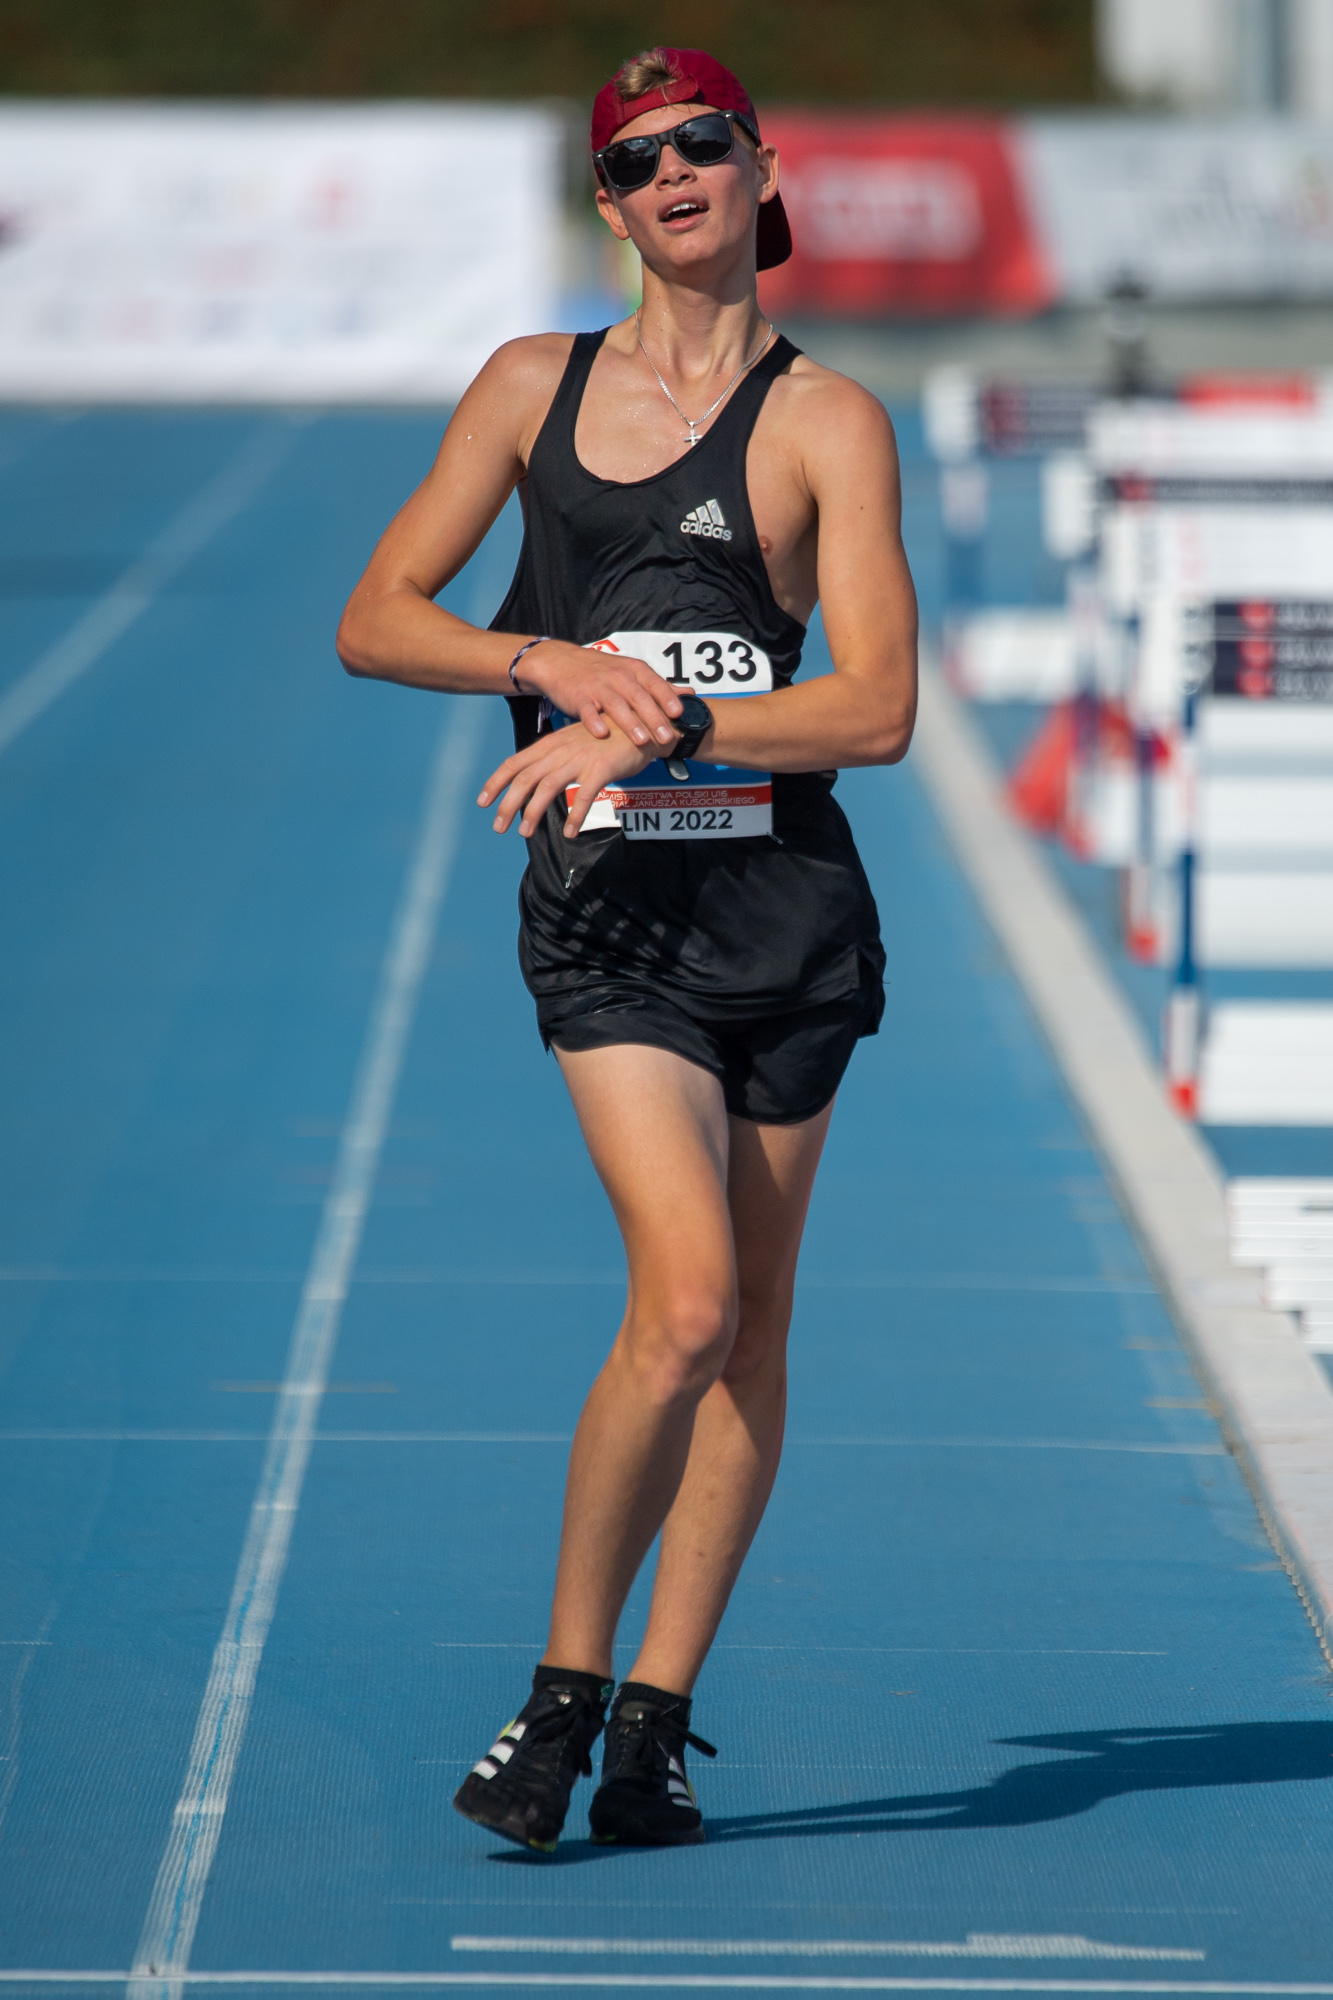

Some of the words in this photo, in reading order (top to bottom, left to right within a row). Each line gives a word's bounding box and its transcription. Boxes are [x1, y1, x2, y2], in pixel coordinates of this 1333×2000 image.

[680, 520, 732, 541] adidas
[662, 640, 757, 684] 133
[632, 799, 678, 808] JANUSZA
[675, 791, 709, 799] POLSKI
[711, 790, 728, 798] U16
[621, 811, 660, 832] LIN
[670, 809, 733, 831] 2022
